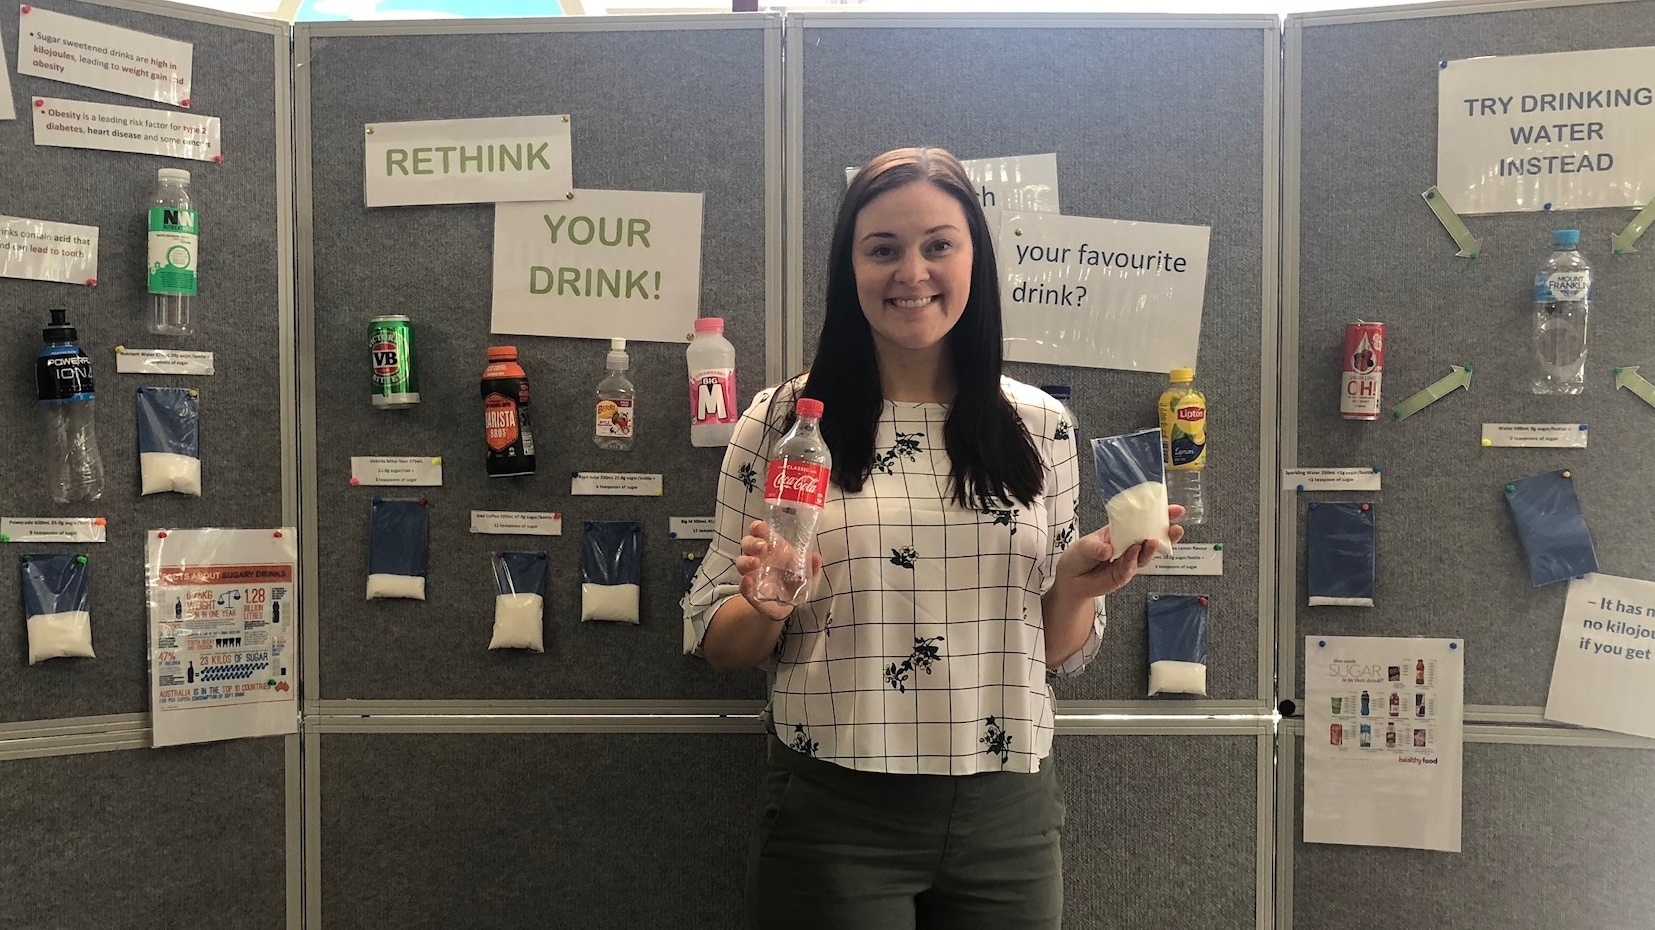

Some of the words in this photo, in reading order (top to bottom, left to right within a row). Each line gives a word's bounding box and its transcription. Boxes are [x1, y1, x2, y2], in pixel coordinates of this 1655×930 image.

[36, 32, 61, 43] Sugar
[62, 39, 108, 54] sweetened
[110, 48, 134, 61] drinks
[151, 58, 168, 68] high
[169, 60, 177, 70] in
[32, 60, 65, 73] obesity
[33, 45, 77, 62] kilojoules,
[79, 55, 109, 70] leading
[121, 66, 148, 78] weight
[151, 72, 168, 81] gain
[169, 76, 184, 85] nd
[1464, 96, 1513, 116] TRY
[1521, 87, 1653, 113] DRINKING
[48, 108, 80, 120] Obesity
[99, 114, 127, 126] leading
[130, 118, 143, 126] risk
[145, 120, 168, 129] factor
[46, 122, 86, 134] diabetes,
[87, 126, 110, 136] heart
[112, 129, 142, 140] disease
[1510, 122, 1604, 144] WATER
[386, 142, 550, 176] RETHINK
[1500, 153, 1614, 176] INSTEAD
[54, 234, 71, 243] acid
[74, 237, 90, 245] that
[544, 214, 651, 248] YOUR
[30, 245, 48, 253] lead
[62, 250, 84, 258] tooth
[1016, 244, 1071, 265] your
[1078, 244, 1187, 273] favourite
[530, 266, 661, 300] DRINK!
[1012, 282, 1087, 306] drink?
[373, 351, 398, 366] VB
[698, 384, 727, 420] M
[1180, 409, 1203, 419] Lipton
[773, 472, 820, 493] Coca-Cola
[191, 572, 220, 580] ABOUT
[222, 570, 253, 579] SUGARY
[255, 569, 286, 578] DRINKS
[244, 588, 265, 603] 1.28
[244, 604, 263, 612] BILLION
[1600, 597, 1613, 611] It
[1616, 600, 1642, 615] has
[1584, 619, 1602, 630] no
[159, 652, 176, 661] 47%
[1579, 637, 1591, 650] if
[1594, 642, 1622, 655] you
[1625, 647, 1651, 660] get
[200, 656, 208, 665] 23
[212, 654, 231, 664] KILOS
[234, 654, 242, 662] OF
[246, 652, 268, 662] SUGAR
[1329, 664, 1381, 678] SUGAR
[160, 689, 191, 697] AUSTRALIA
